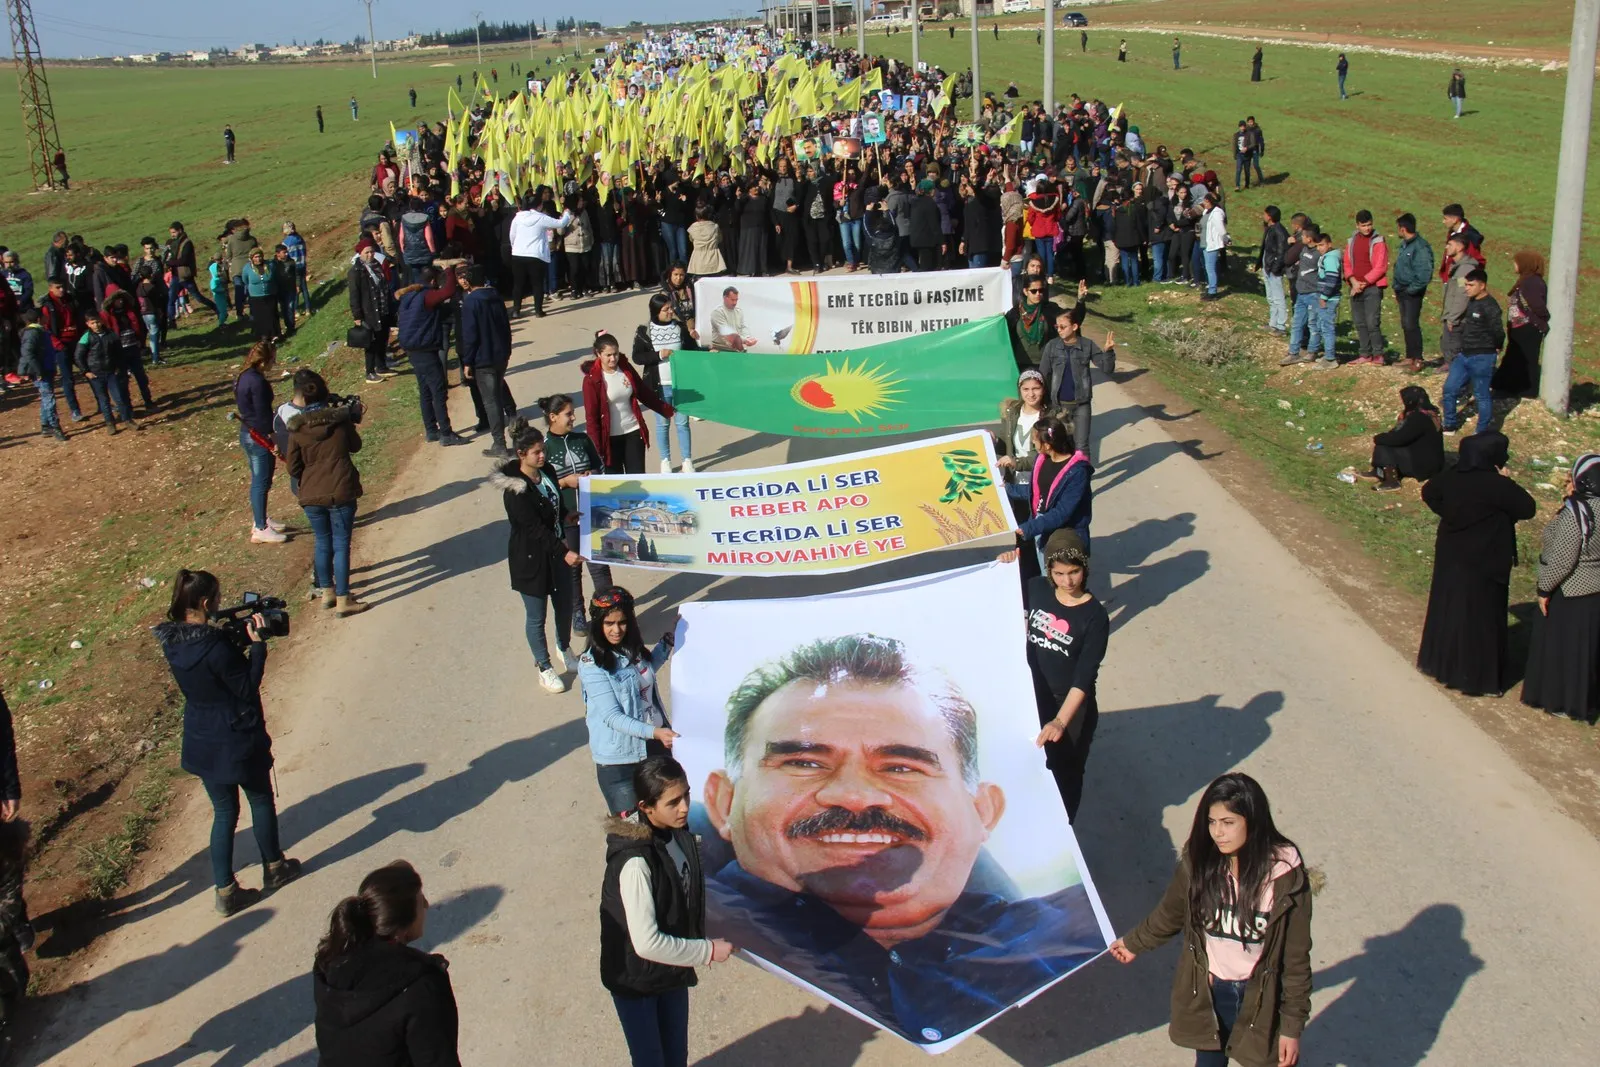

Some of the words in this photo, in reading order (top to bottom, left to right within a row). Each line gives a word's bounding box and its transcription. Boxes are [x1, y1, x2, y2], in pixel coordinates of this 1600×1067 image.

[827, 292, 854, 308] EMÊ
[858, 290, 909, 307] TECRÎD
[913, 289, 922, 304] Û
[927, 285, 984, 306] FAŞÎZMÊ
[851, 319, 875, 334] TÊK
[695, 481, 800, 501] TECRÎDA
[807, 474, 828, 492] Lİ
[835, 469, 880, 489] SER
[730, 500, 807, 518] REBER
[817, 494, 869, 512] APO
[711, 526, 820, 544] TECRÎDA
[827, 519, 848, 537] Lİ
[855, 515, 902, 533] SER
[874, 536, 906, 551] YE
